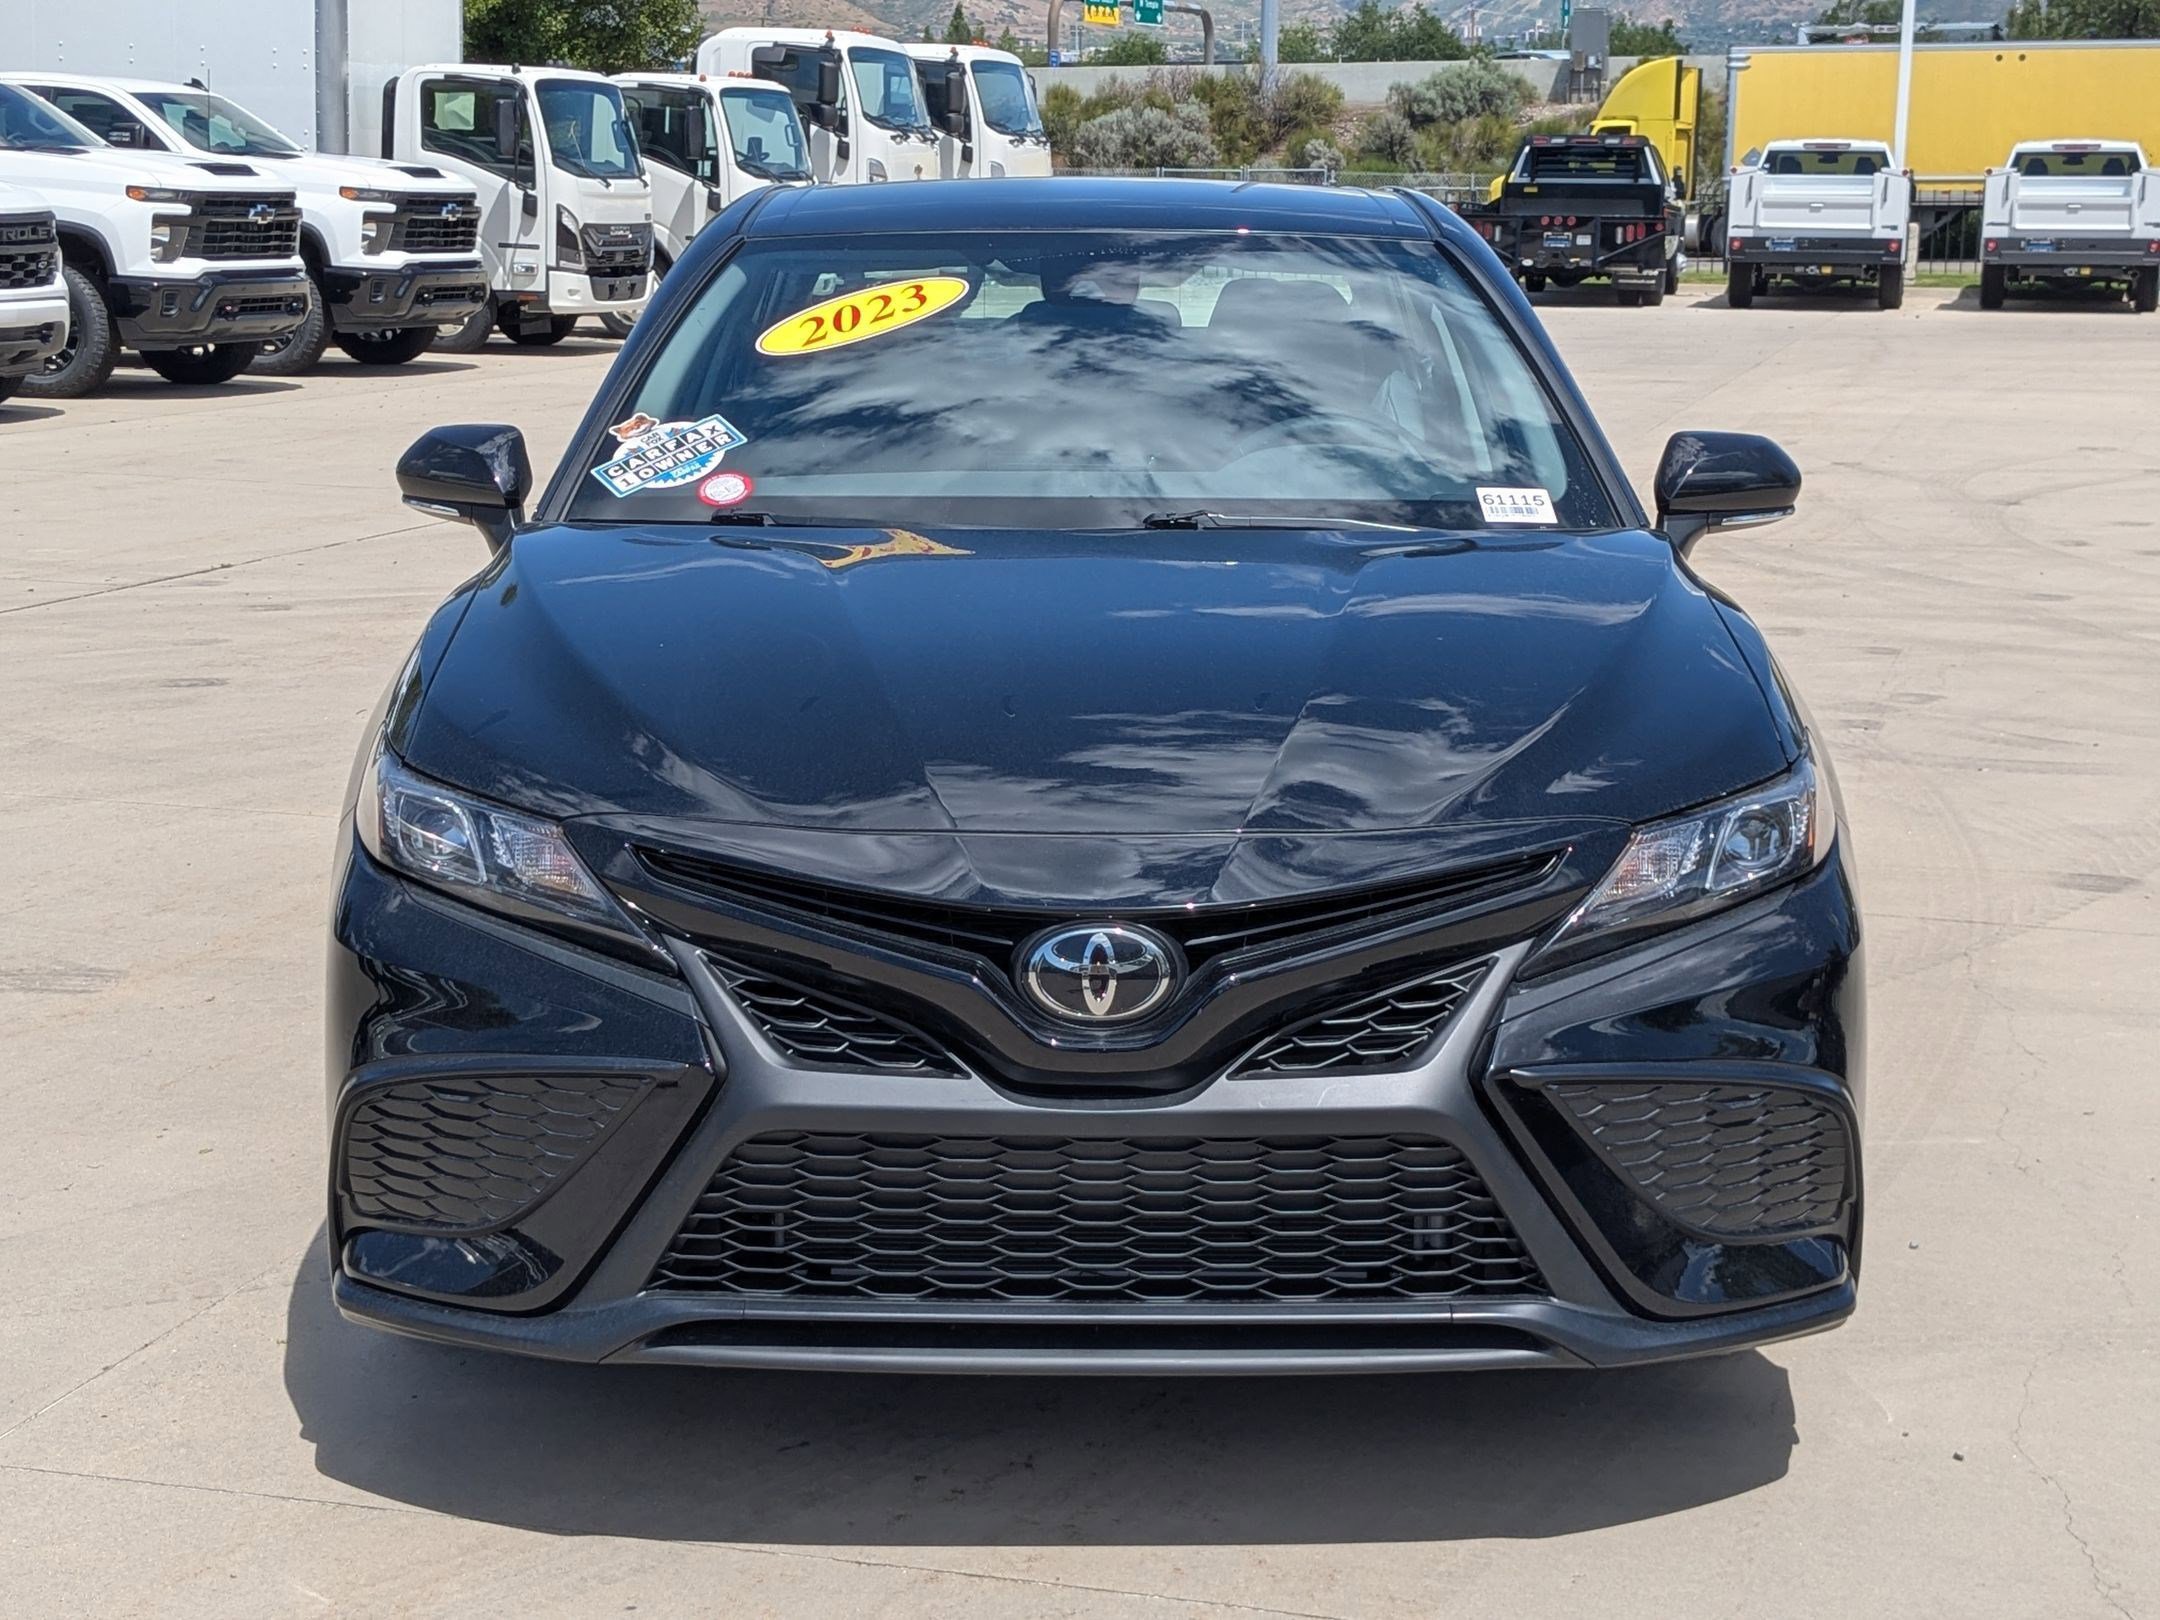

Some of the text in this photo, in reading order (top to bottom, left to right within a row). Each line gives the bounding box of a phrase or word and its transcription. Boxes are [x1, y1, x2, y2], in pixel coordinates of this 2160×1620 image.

[799, 284, 928, 347] 2023
[607, 425, 720, 477] CARFAX
[636, 432, 732, 479] OWNER
[1482, 494, 1545, 506] 61115
